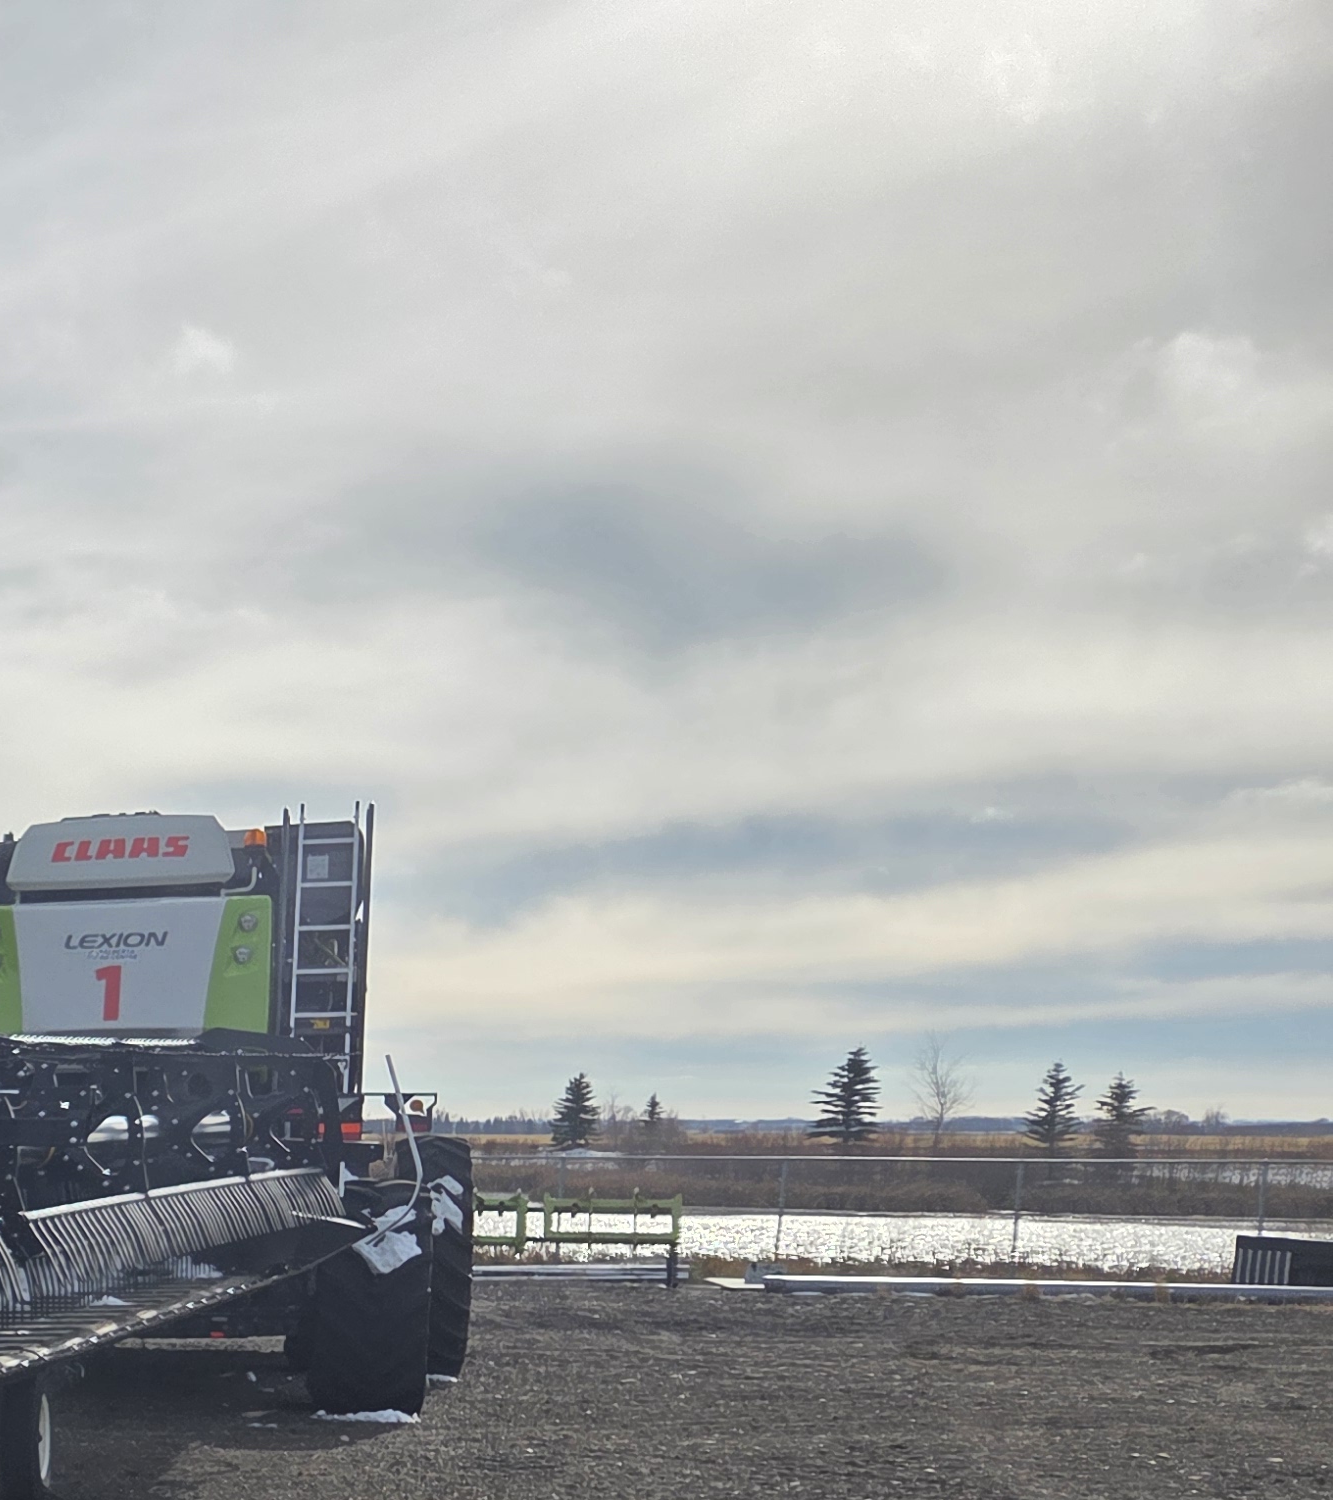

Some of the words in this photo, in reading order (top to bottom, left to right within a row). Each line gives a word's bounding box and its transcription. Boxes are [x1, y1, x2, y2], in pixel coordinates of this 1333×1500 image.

[51, 836, 190, 863] CLAAS
[64, 931, 168, 950] LEXION
[95, 965, 122, 1021] 1
